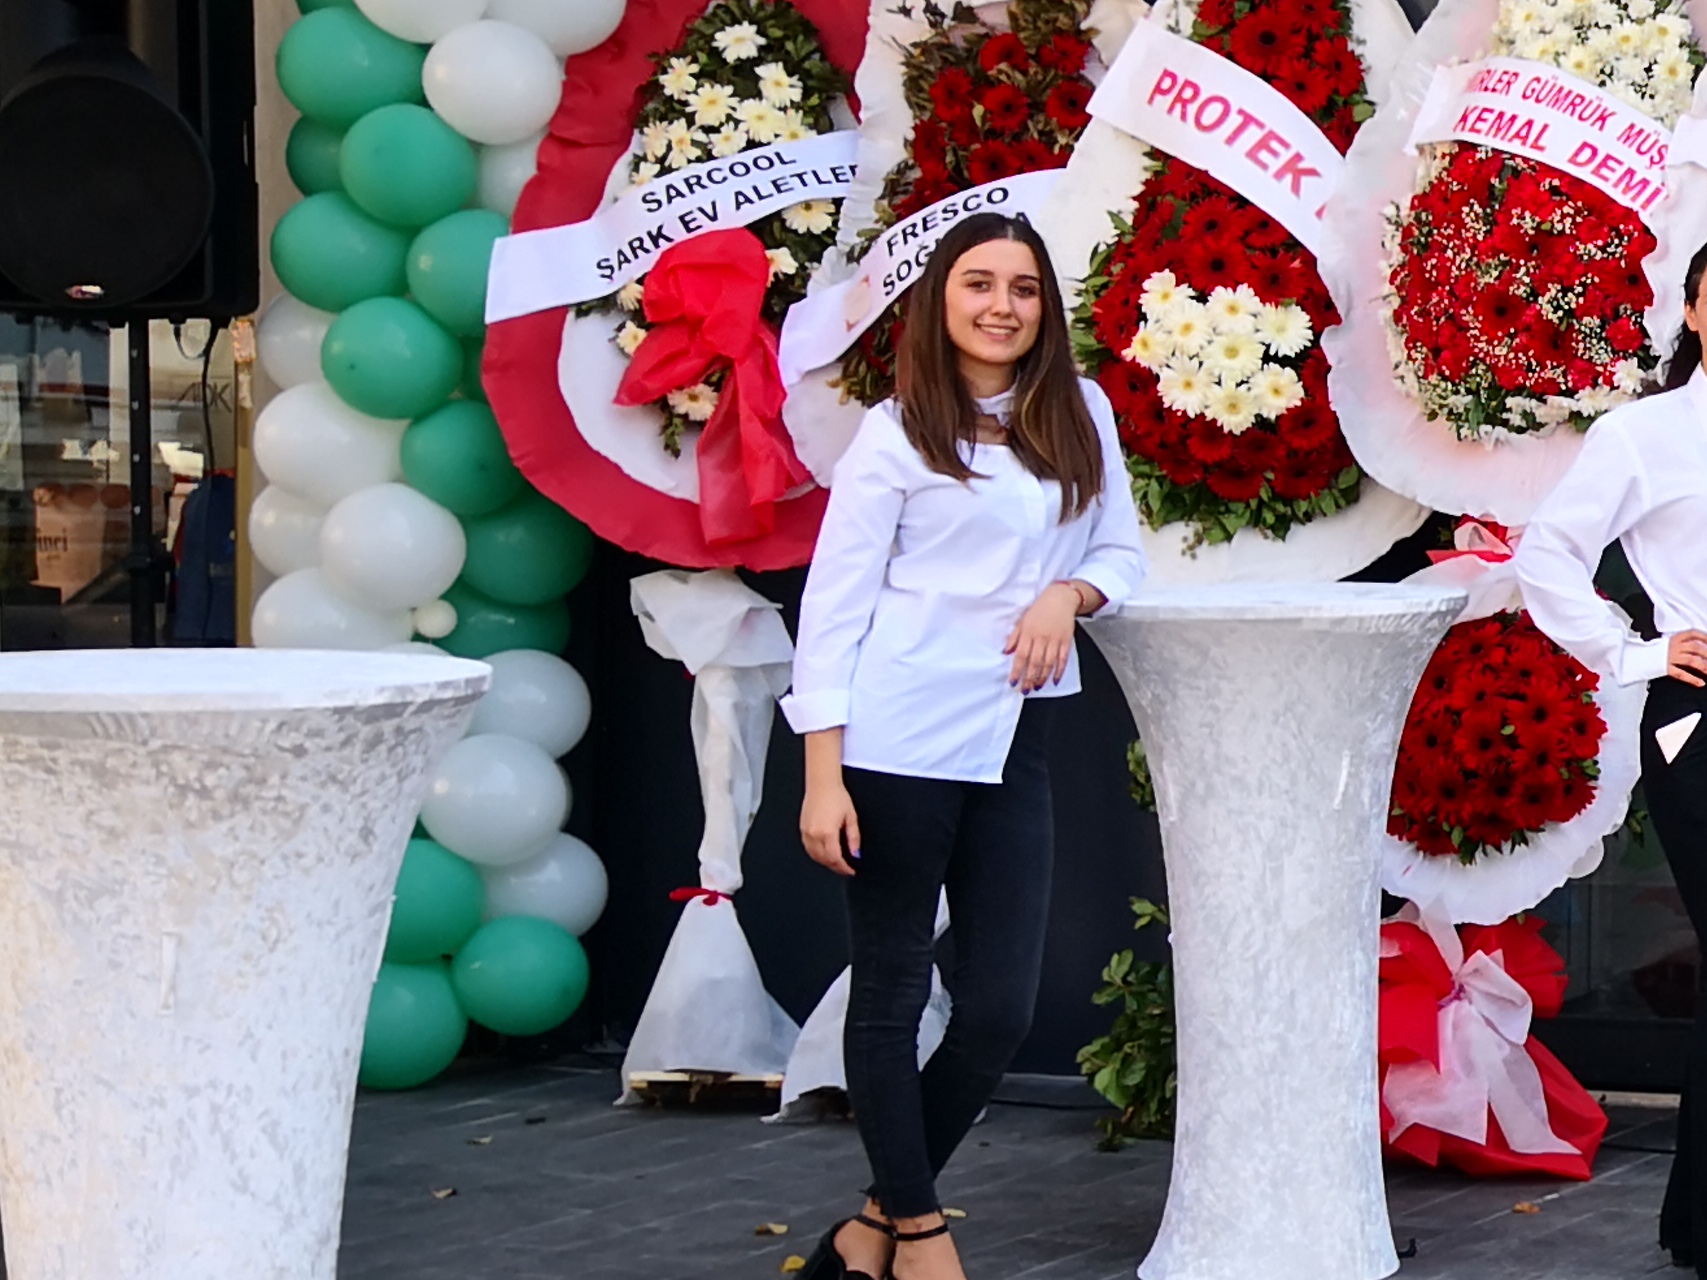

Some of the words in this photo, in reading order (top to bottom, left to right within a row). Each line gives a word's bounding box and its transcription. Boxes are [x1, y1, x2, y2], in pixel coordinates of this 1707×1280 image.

[1147, 67, 1323, 200] PROTEK
[1453, 105, 1551, 154] KEMAL
[1567, 140, 1669, 212] DEMİ
[1616, 122, 1669, 171] MÜŞ
[641, 150, 797, 214] SARCOOL
[595, 224, 675, 282] ŞARK
[678, 199, 720, 234] EV
[886, 186, 1010, 258] FRESCO
